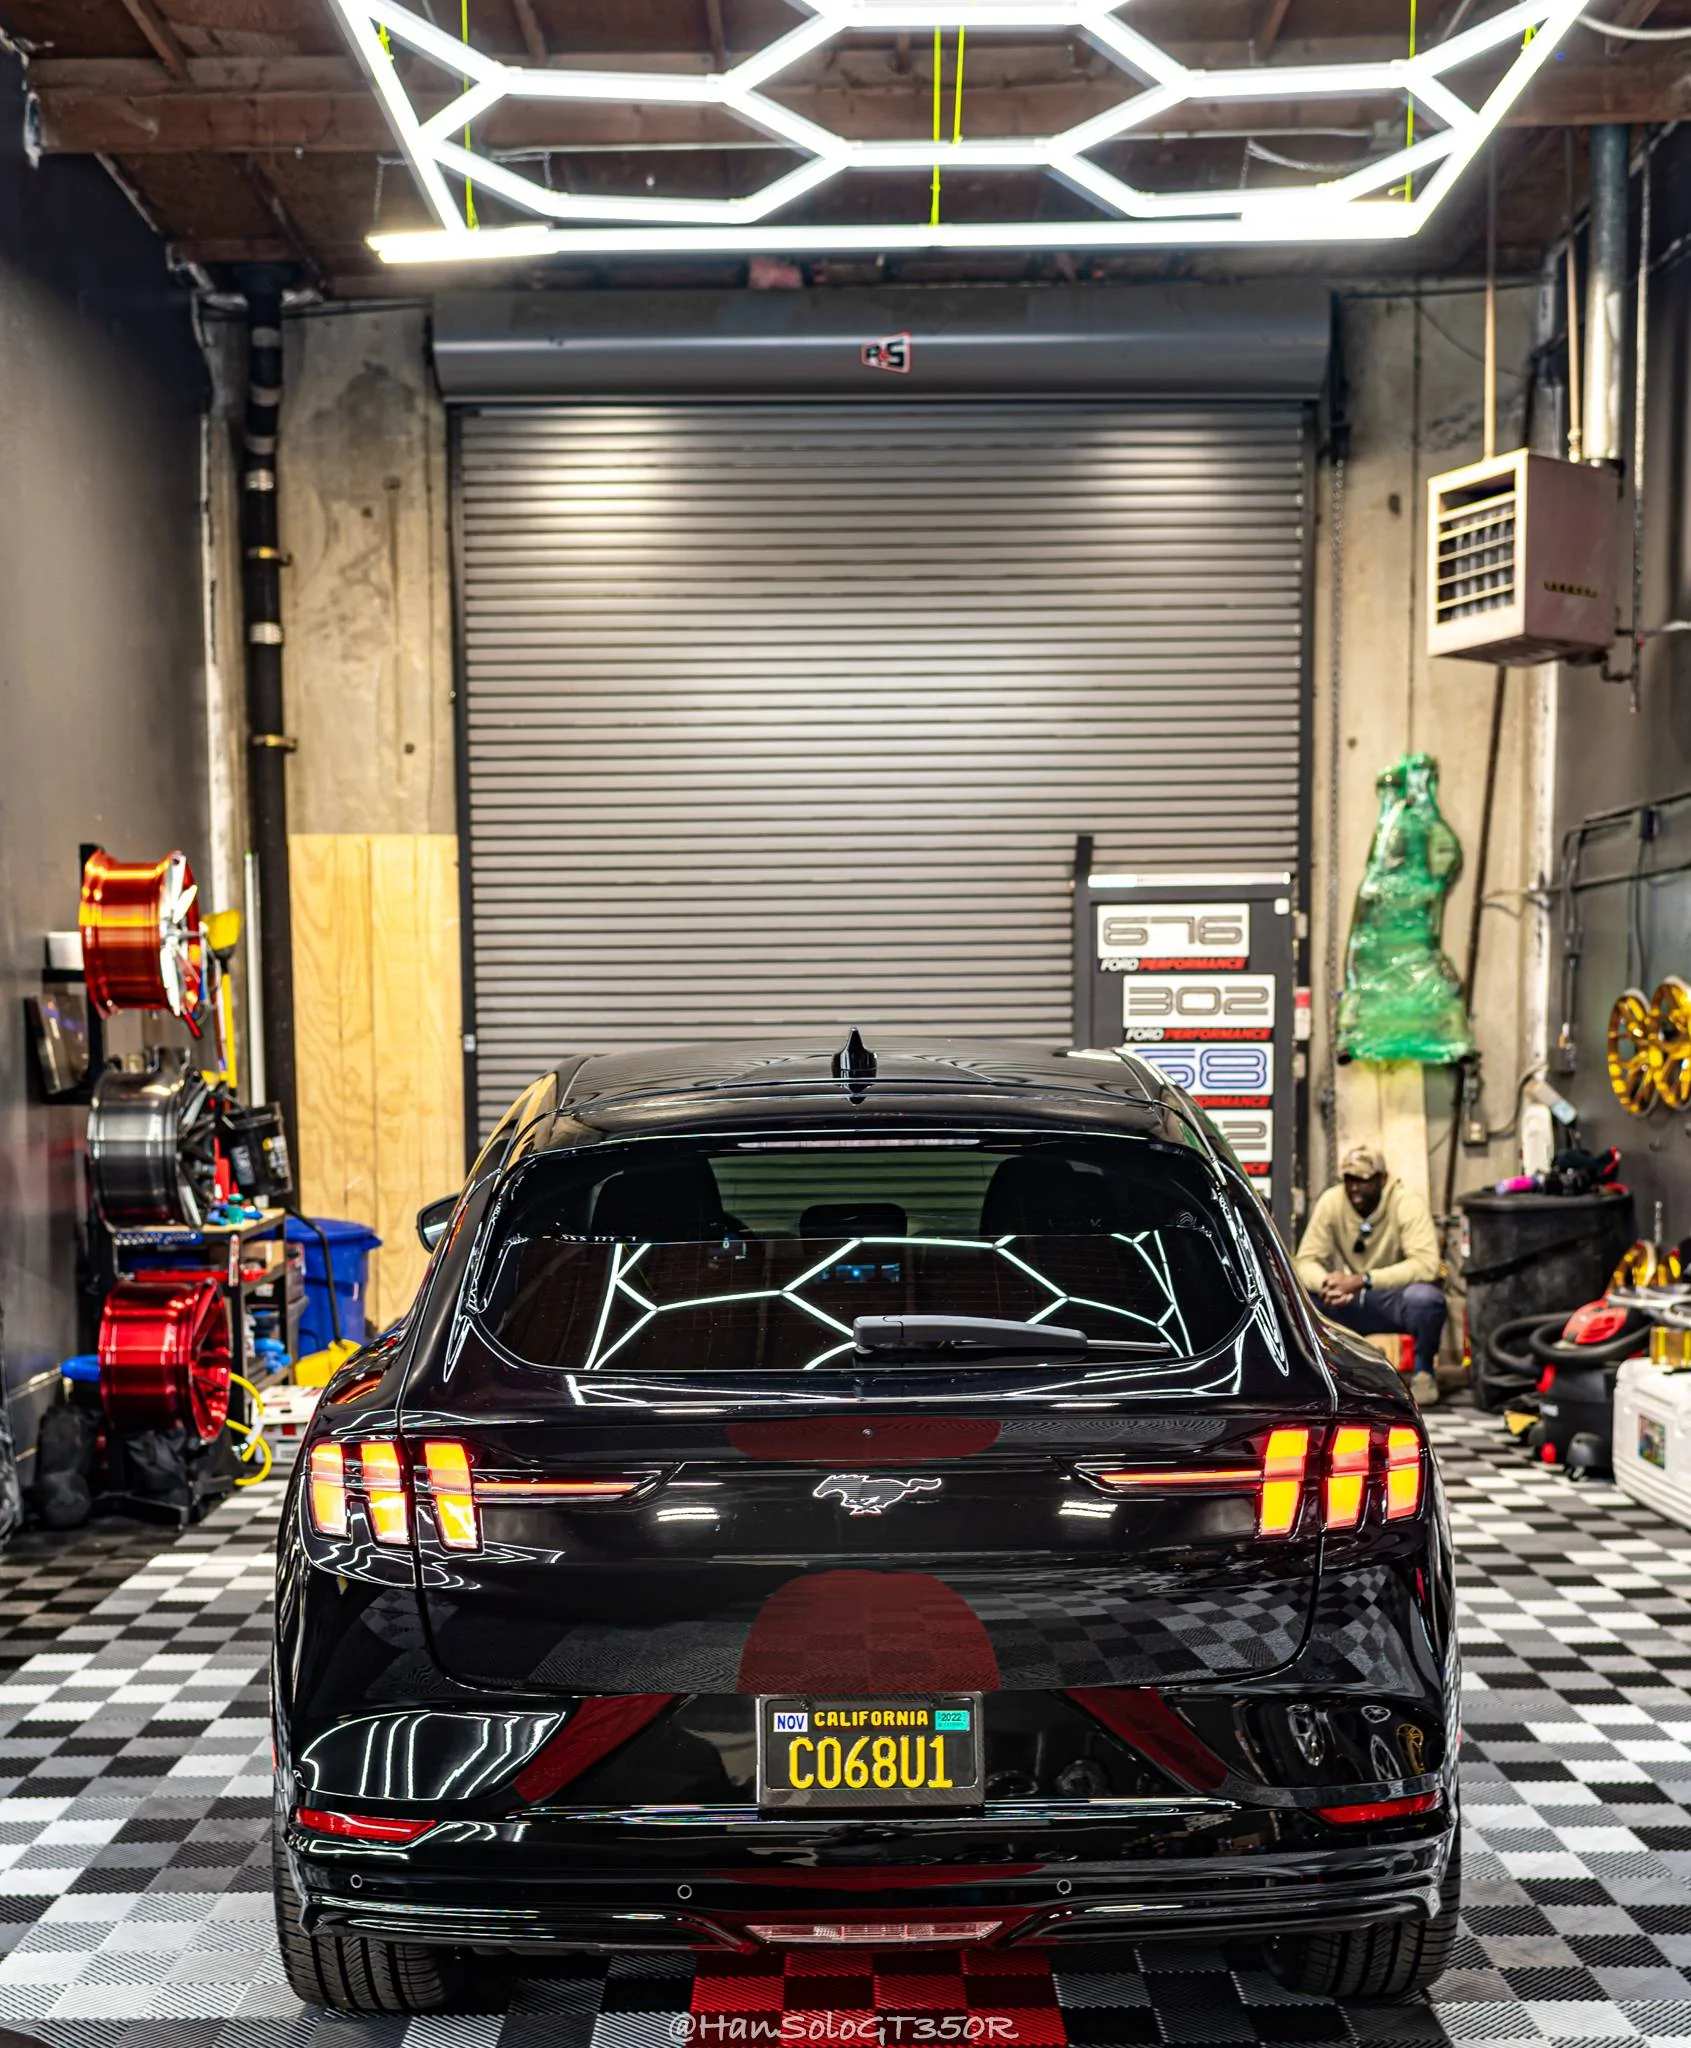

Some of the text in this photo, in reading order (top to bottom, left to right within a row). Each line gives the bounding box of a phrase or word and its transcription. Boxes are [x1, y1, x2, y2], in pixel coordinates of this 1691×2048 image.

[1103, 915, 1243, 946] 676
[1100, 957, 1247, 972] FORD PERFORMANCE
[1128, 986, 1269, 1016] 302
[1125, 1027, 1272, 1041] FORD PERFORMANCE
[1194, 1095, 1270, 1108] ORMANCE
[777, 1715, 805, 1730] NOV
[814, 1710, 929, 1727] CALIFORNIA
[941, 1712, 962, 1722] 2022
